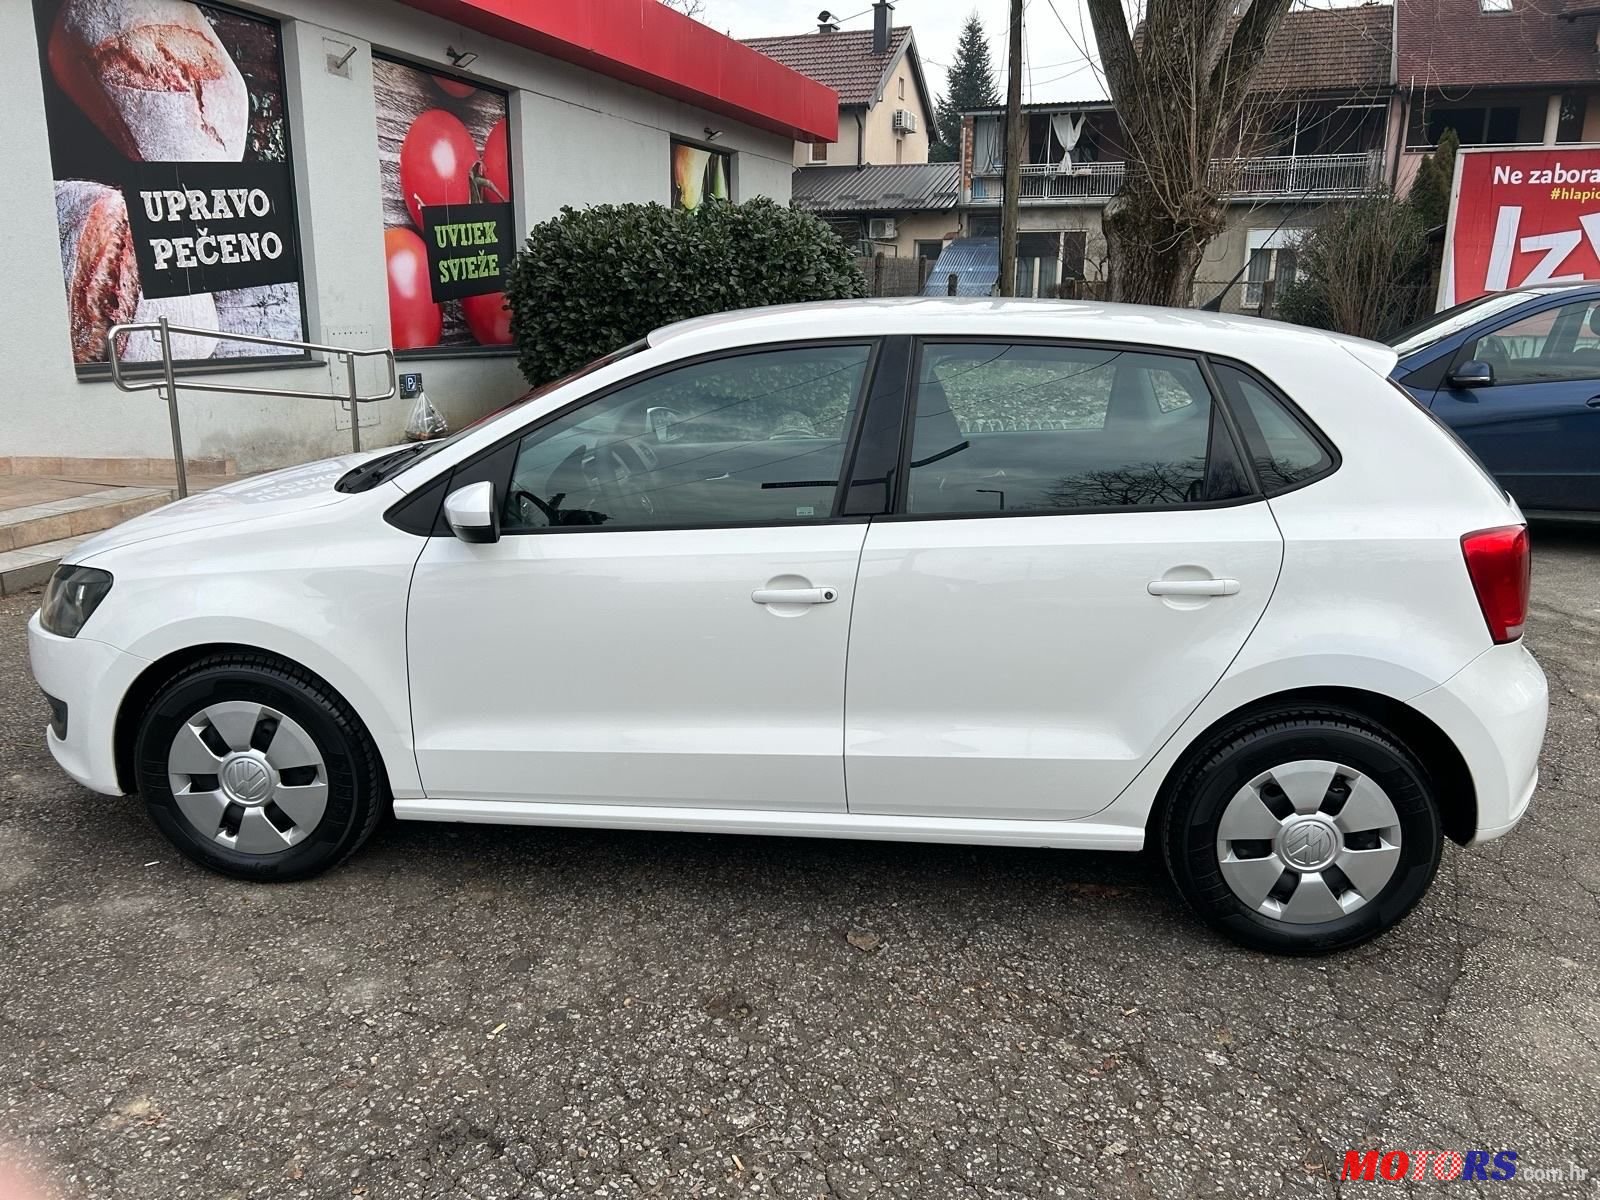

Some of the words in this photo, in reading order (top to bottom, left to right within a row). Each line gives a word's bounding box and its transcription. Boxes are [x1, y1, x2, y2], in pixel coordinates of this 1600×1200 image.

[1493, 165, 1523, 184] Ne
[1528, 162, 1600, 184] zabora
[140, 188, 270, 221] UPRAVO
[149, 227, 283, 270] PEČENO
[434, 221, 498, 248] UVIJEK
[438, 249, 499, 283] SVJEŽE
